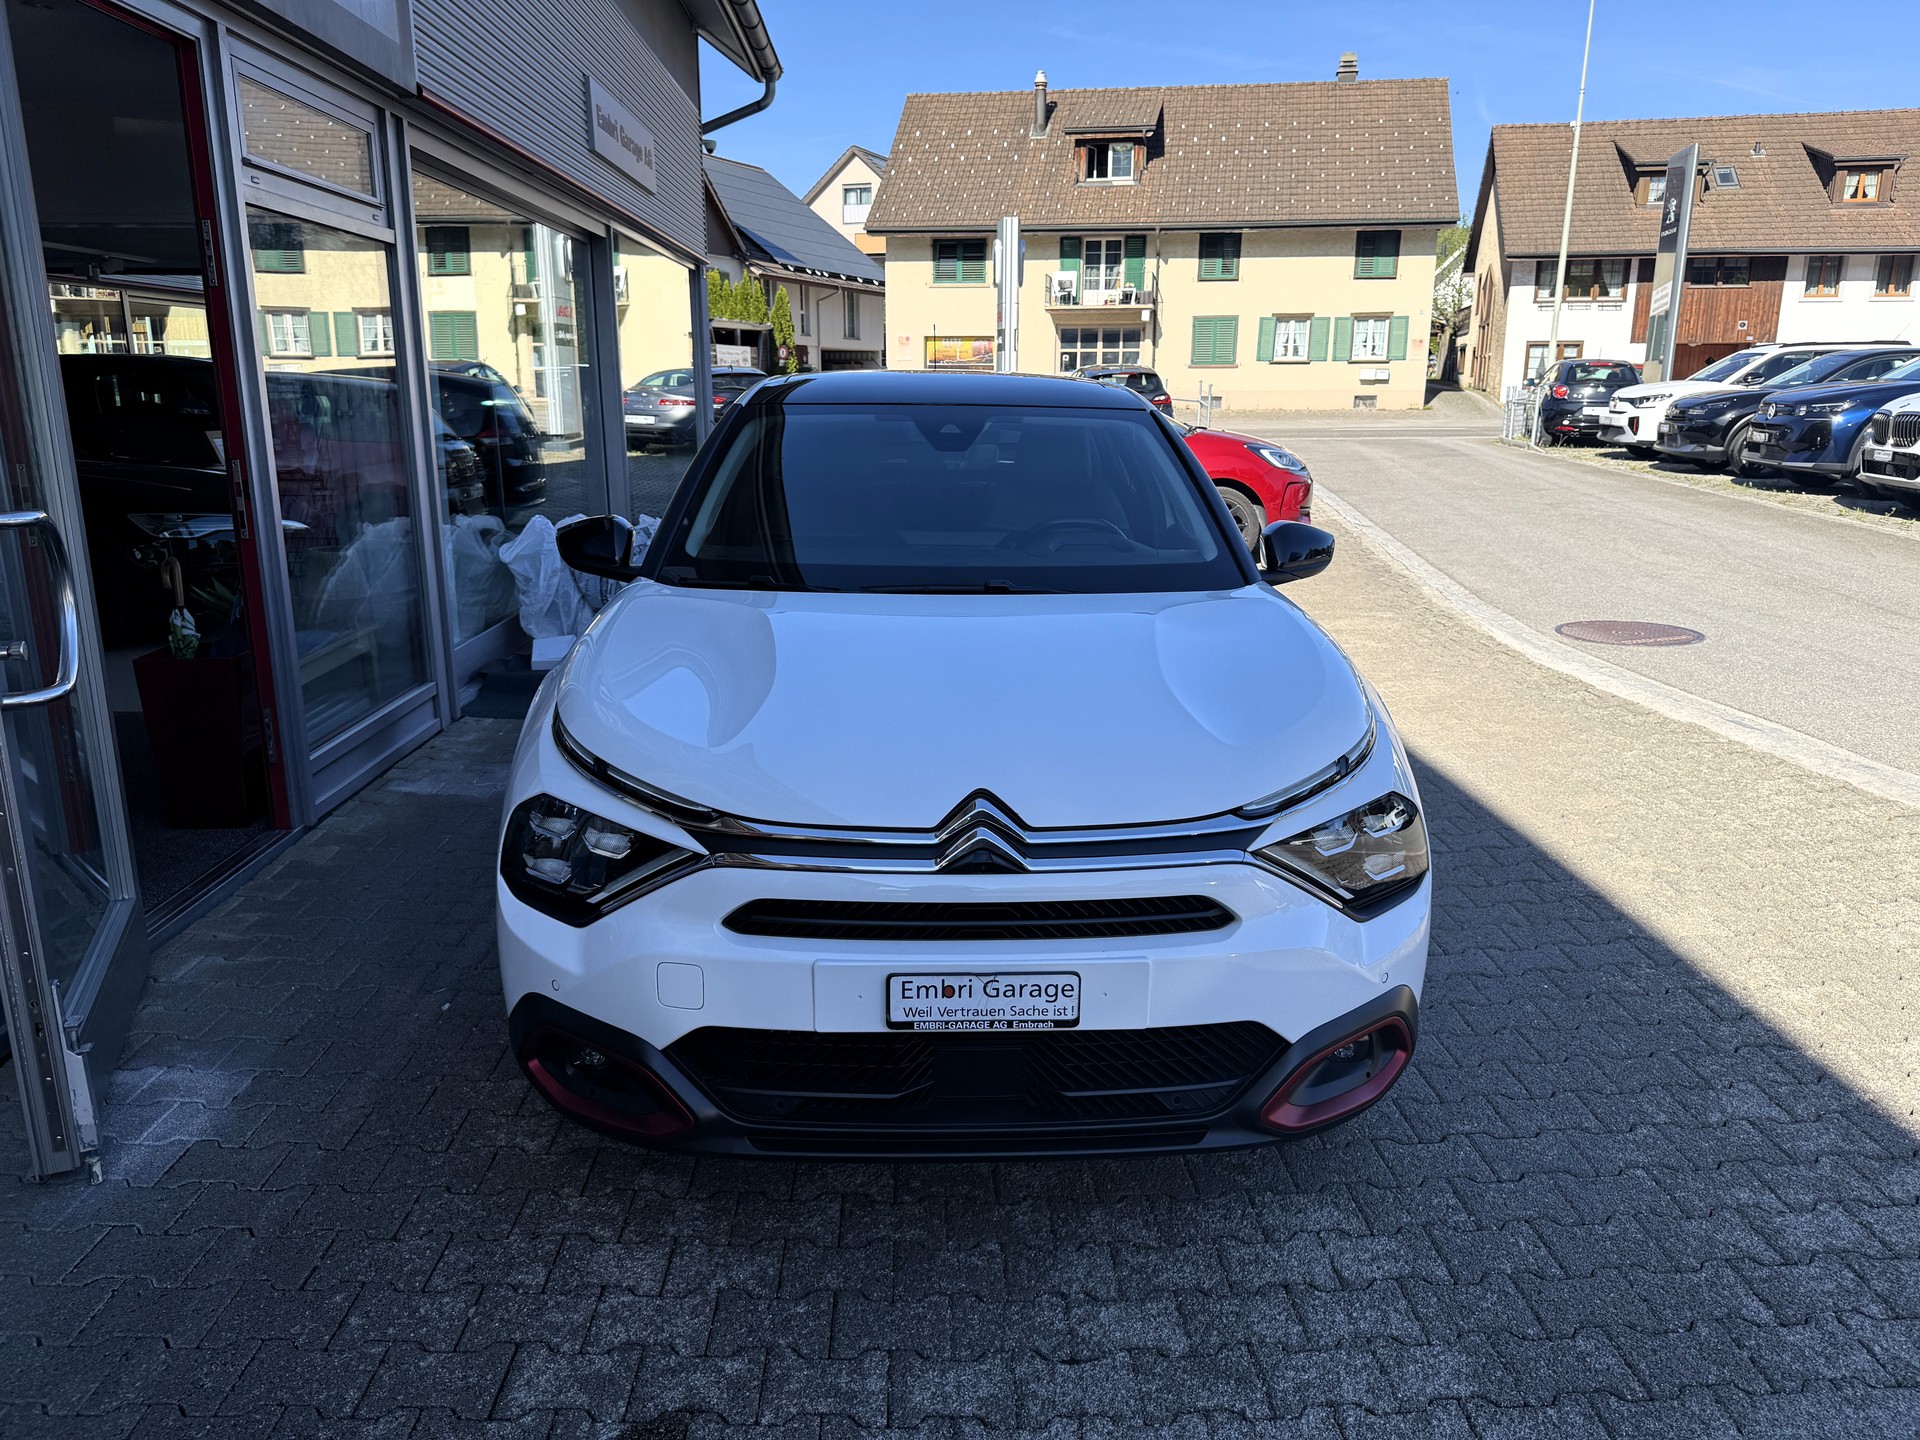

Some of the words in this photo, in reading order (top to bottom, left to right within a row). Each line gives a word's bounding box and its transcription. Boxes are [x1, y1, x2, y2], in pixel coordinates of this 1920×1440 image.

[595, 103, 619, 142] Embri
[620, 124, 643, 163] Garage
[901, 979, 973, 999] Embri
[983, 979, 1075, 1003] Garage
[903, 1006, 932, 1018] Weil
[937, 1005, 1006, 1018] Vertrauen
[1010, 1005, 1049, 1017] Sache
[913, 1021, 990, 1030] EMBRI-GARAGE
[992, 1020, 1008, 1029] AG
[1013, 1020, 1054, 1029] Embrach
